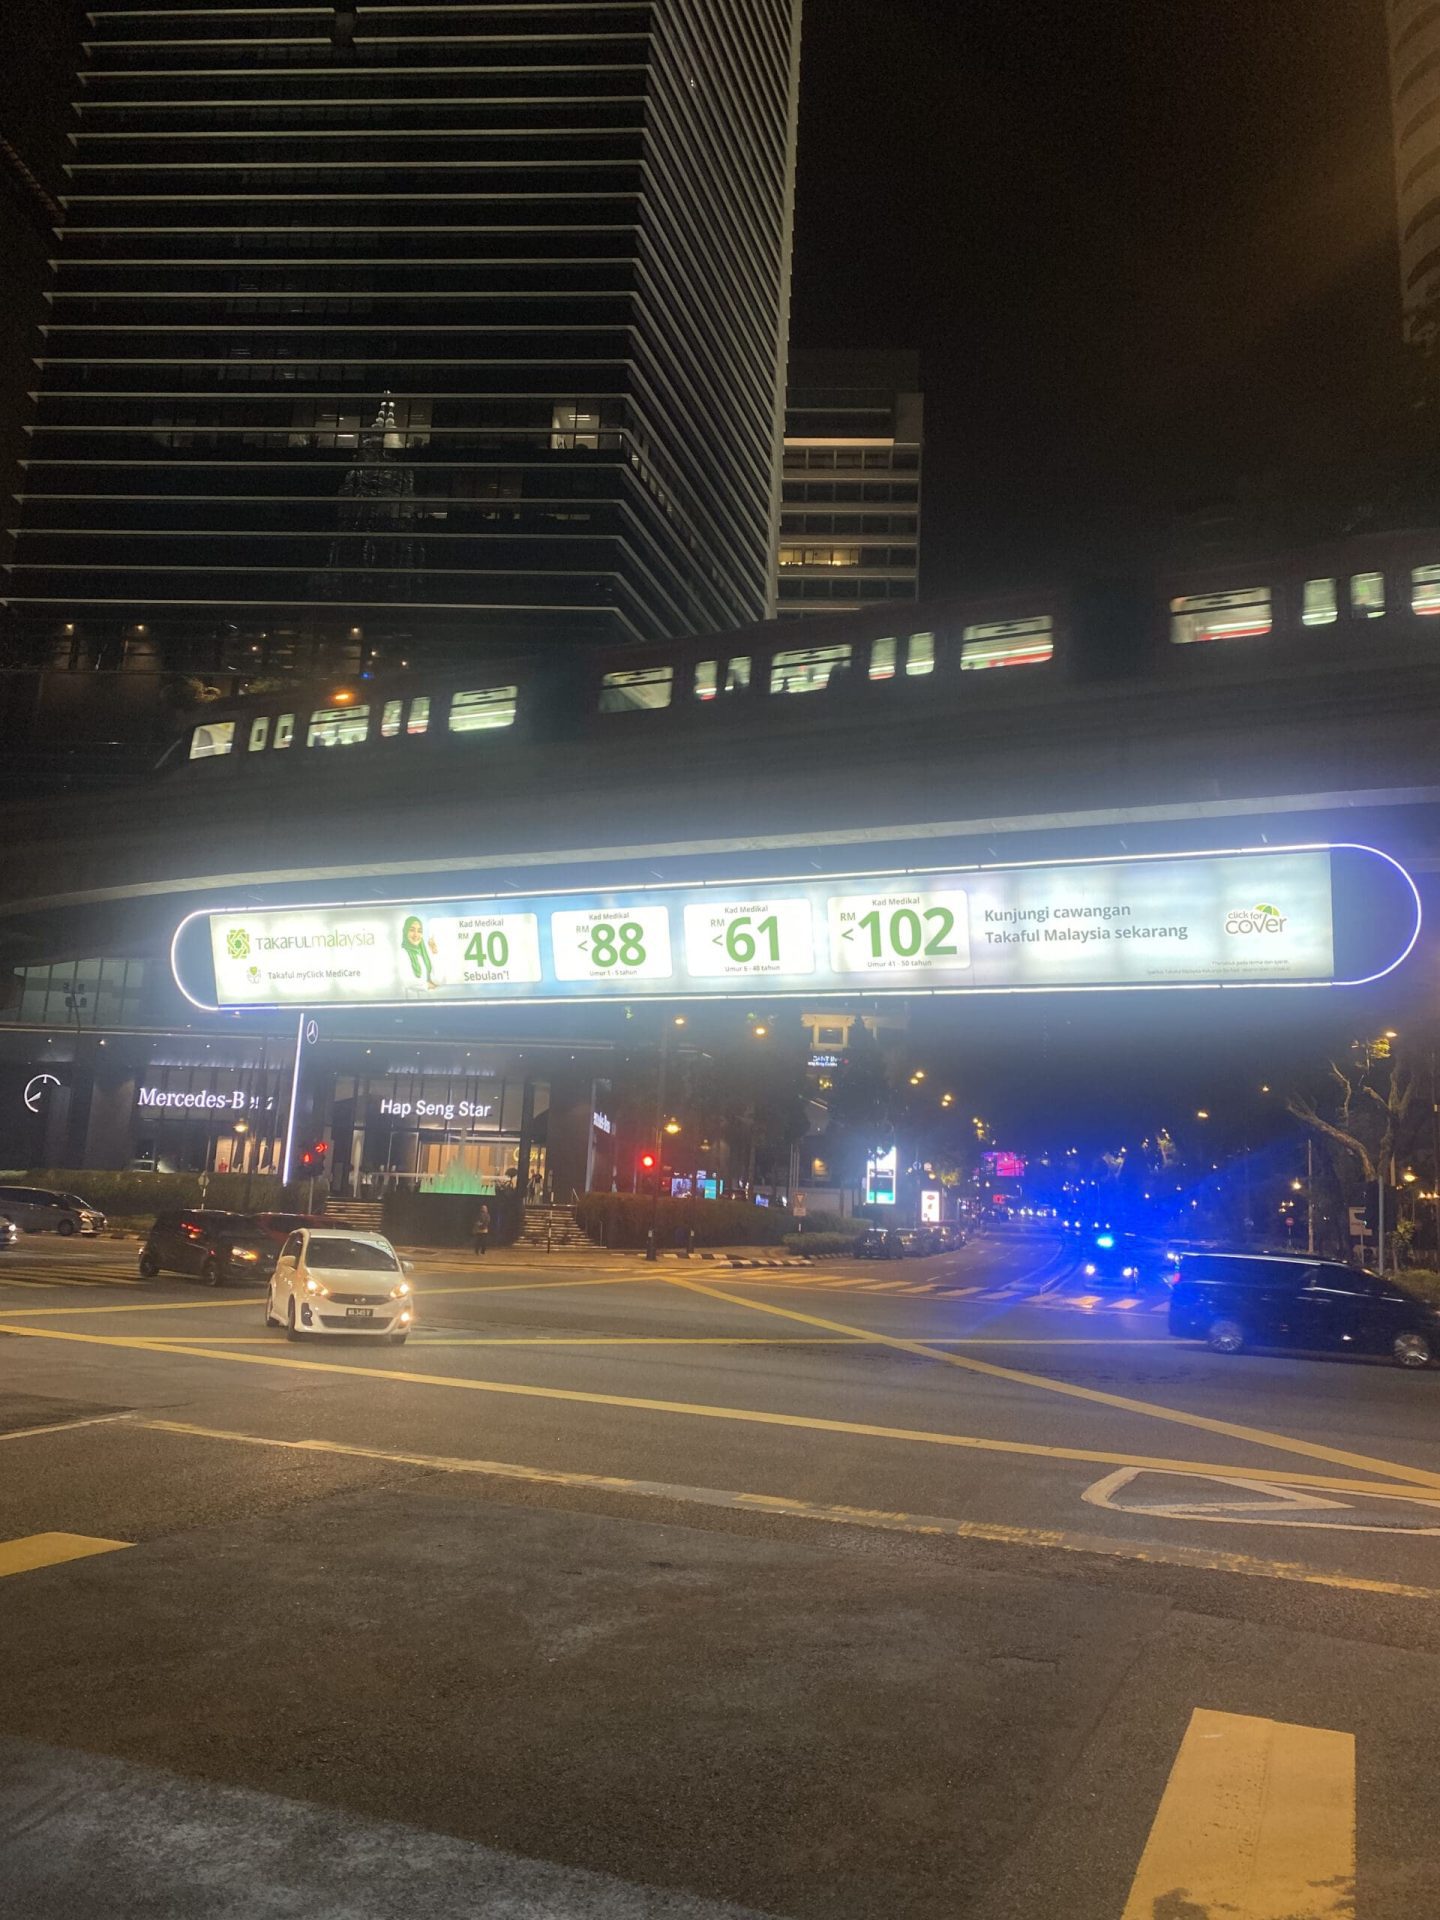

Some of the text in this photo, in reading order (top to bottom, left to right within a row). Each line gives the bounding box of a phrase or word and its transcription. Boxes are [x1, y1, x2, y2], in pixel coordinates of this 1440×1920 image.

[888, 896, 920, 905] Medikal
[724, 905, 768, 914] Kad Medikal
[984, 904, 1131, 924] Kunjungi cawangan
[589, 912, 630, 921] Kad Medikal
[840, 912, 856, 921] RM
[1228, 911, 1262, 920] click for
[459, 919, 504, 928] Kad Medikal
[710, 919, 725, 927] RM
[1225, 914, 1287, 935] cover
[576, 925, 589, 934] RM
[857, 906, 958, 958] 102
[985, 925, 1188, 944] Takaful Malaysia sekarang
[726, 916, 780, 963] 61
[464, 930, 509, 967] 40
[591, 922, 646, 967] 88
[268, 971, 295, 980] Takaful
[380, 1099, 492, 1120] Hap Seng Star
